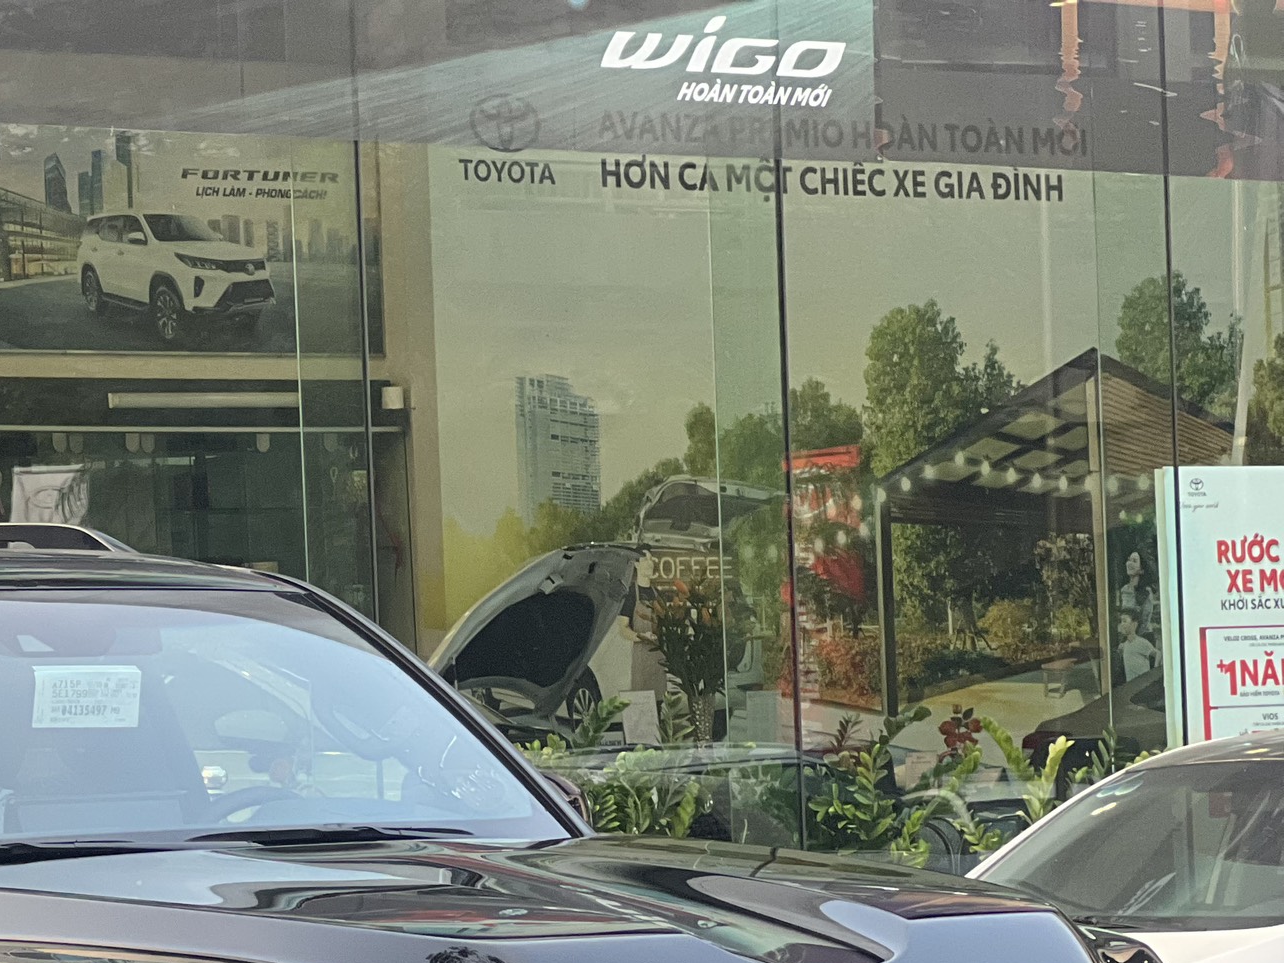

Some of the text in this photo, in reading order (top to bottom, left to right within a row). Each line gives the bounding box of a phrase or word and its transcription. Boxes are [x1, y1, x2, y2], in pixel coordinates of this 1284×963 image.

[677, 78, 833, 108] HOÀN TOÀN MỚI
[728, 115, 844, 149] PRMIO
[944, 117, 1024, 154] TOÀN
[180, 168, 340, 184] FORTUNER
[459, 158, 556, 185] TOYOTA
[601, 154, 671, 190] HƠN
[893, 169, 926, 198] XE
[934, 169, 986, 200] GIA
[991, 167, 1063, 202] ĐÌNH
[255, 187, 291, 199] PHONG
[1217, 533, 1281, 564] RƯỚC
[649, 557, 733, 579] COFFEE
[1226, 569, 1254, 593] XE
[1262, 713, 1279, 721] VIOS
